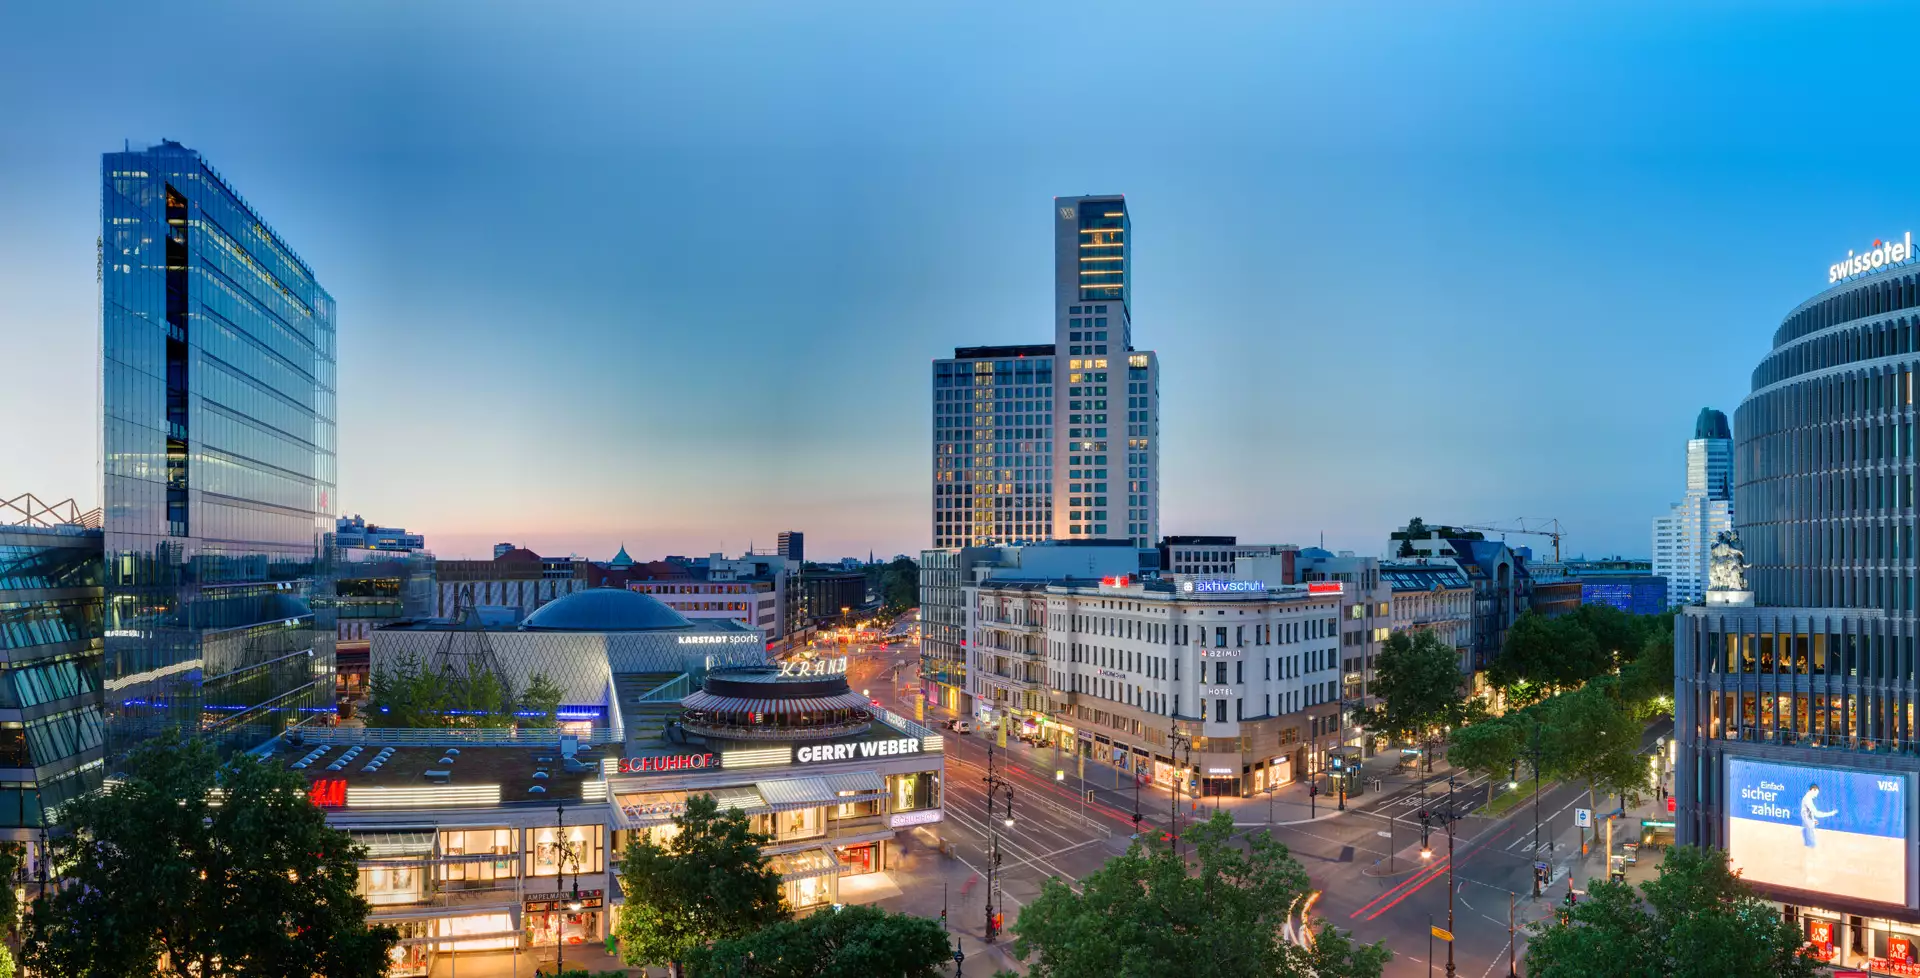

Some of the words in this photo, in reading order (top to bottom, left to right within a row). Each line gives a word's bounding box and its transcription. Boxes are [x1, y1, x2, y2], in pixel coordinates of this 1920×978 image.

[678, 636, 727, 644] KARSTADT
[729, 634, 759, 645] sports
[797, 742, 857, 763] GERRY
[859, 738, 919, 757] WEBER
[618, 753, 713, 773] SCHUHHOF
[1760, 781, 1785, 791] Einfach
[1877, 780, 1899, 792] VISA
[1742, 785, 1777, 801] sicher
[1752, 803, 1790, 818] zahlen
[527, 891, 570, 900] AMPELMANN
